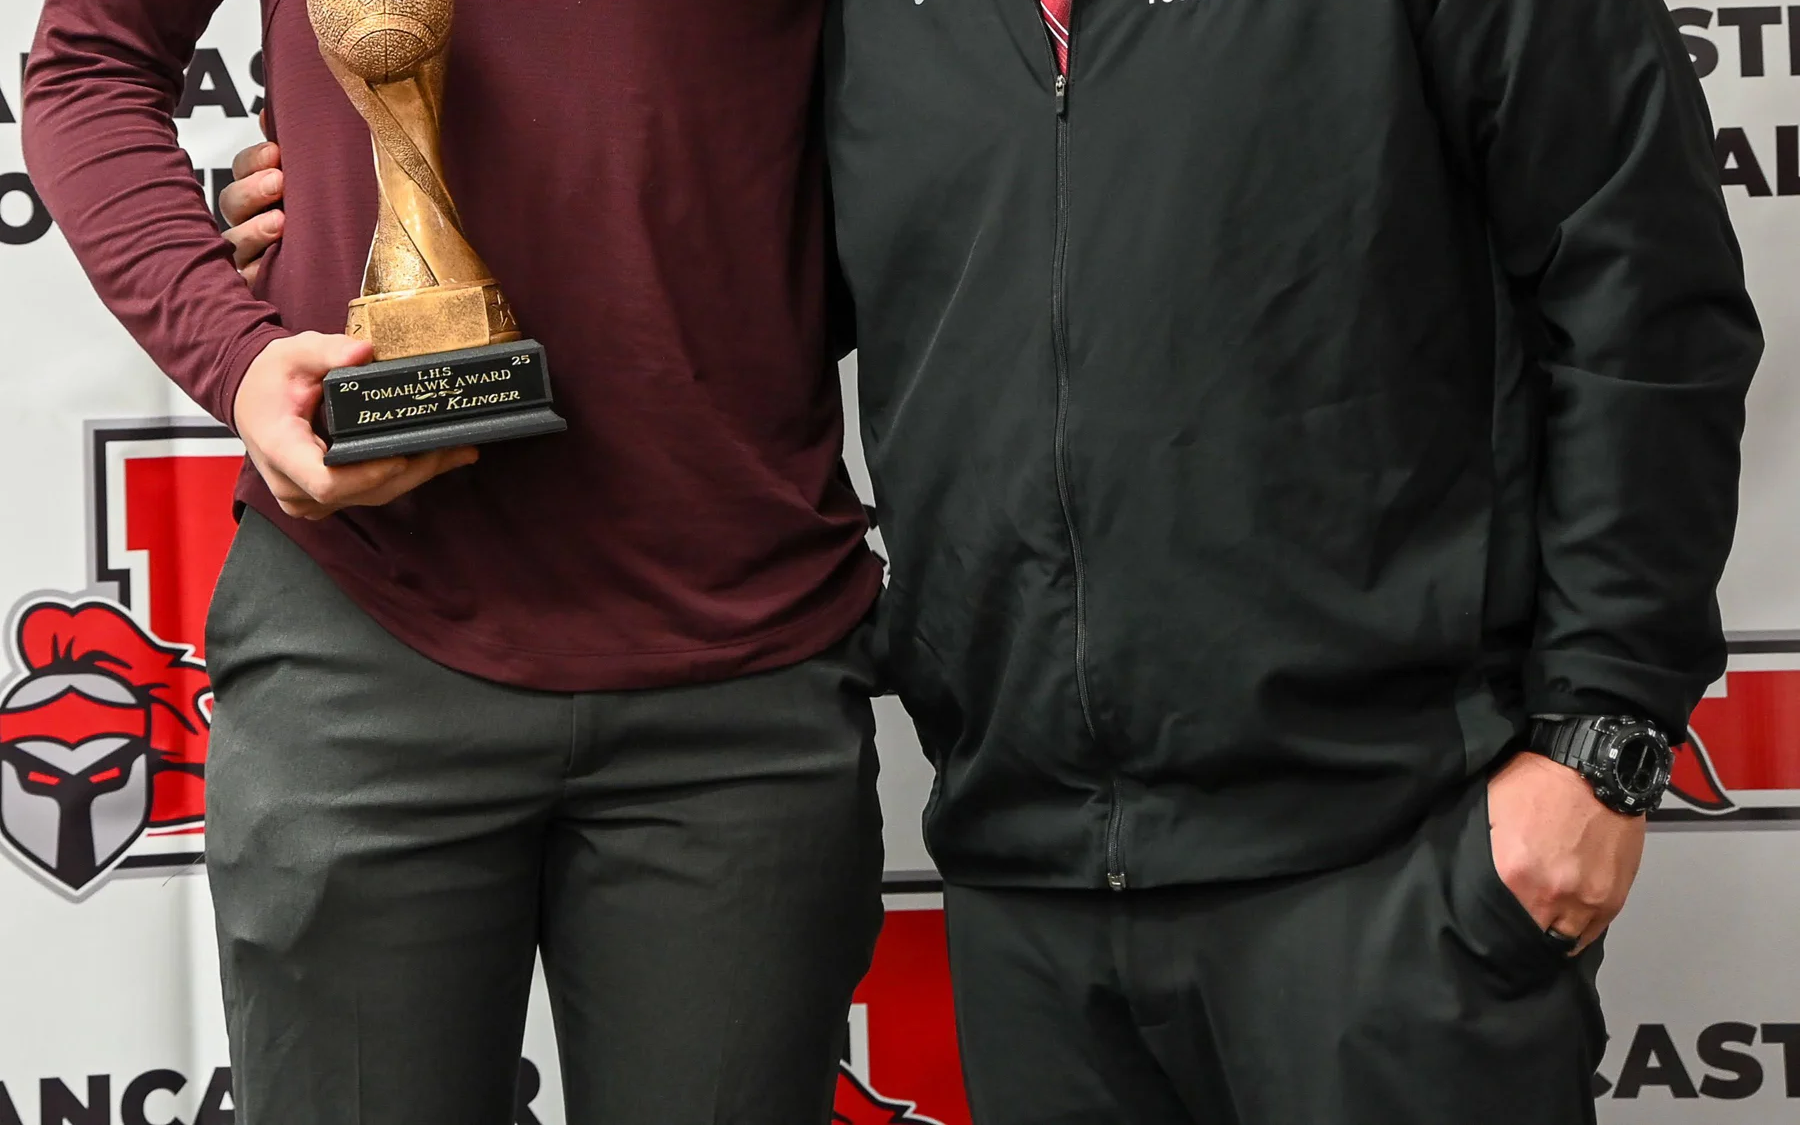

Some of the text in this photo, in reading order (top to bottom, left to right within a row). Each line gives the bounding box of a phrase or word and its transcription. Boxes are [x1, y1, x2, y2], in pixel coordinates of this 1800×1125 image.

[511, 354, 531, 366] 25
[339, 381, 359, 393] 20
[361, 368, 511, 402] TOMAHAWK AWARD
[357, 389, 521, 425] BRAYDEN KLINGER
